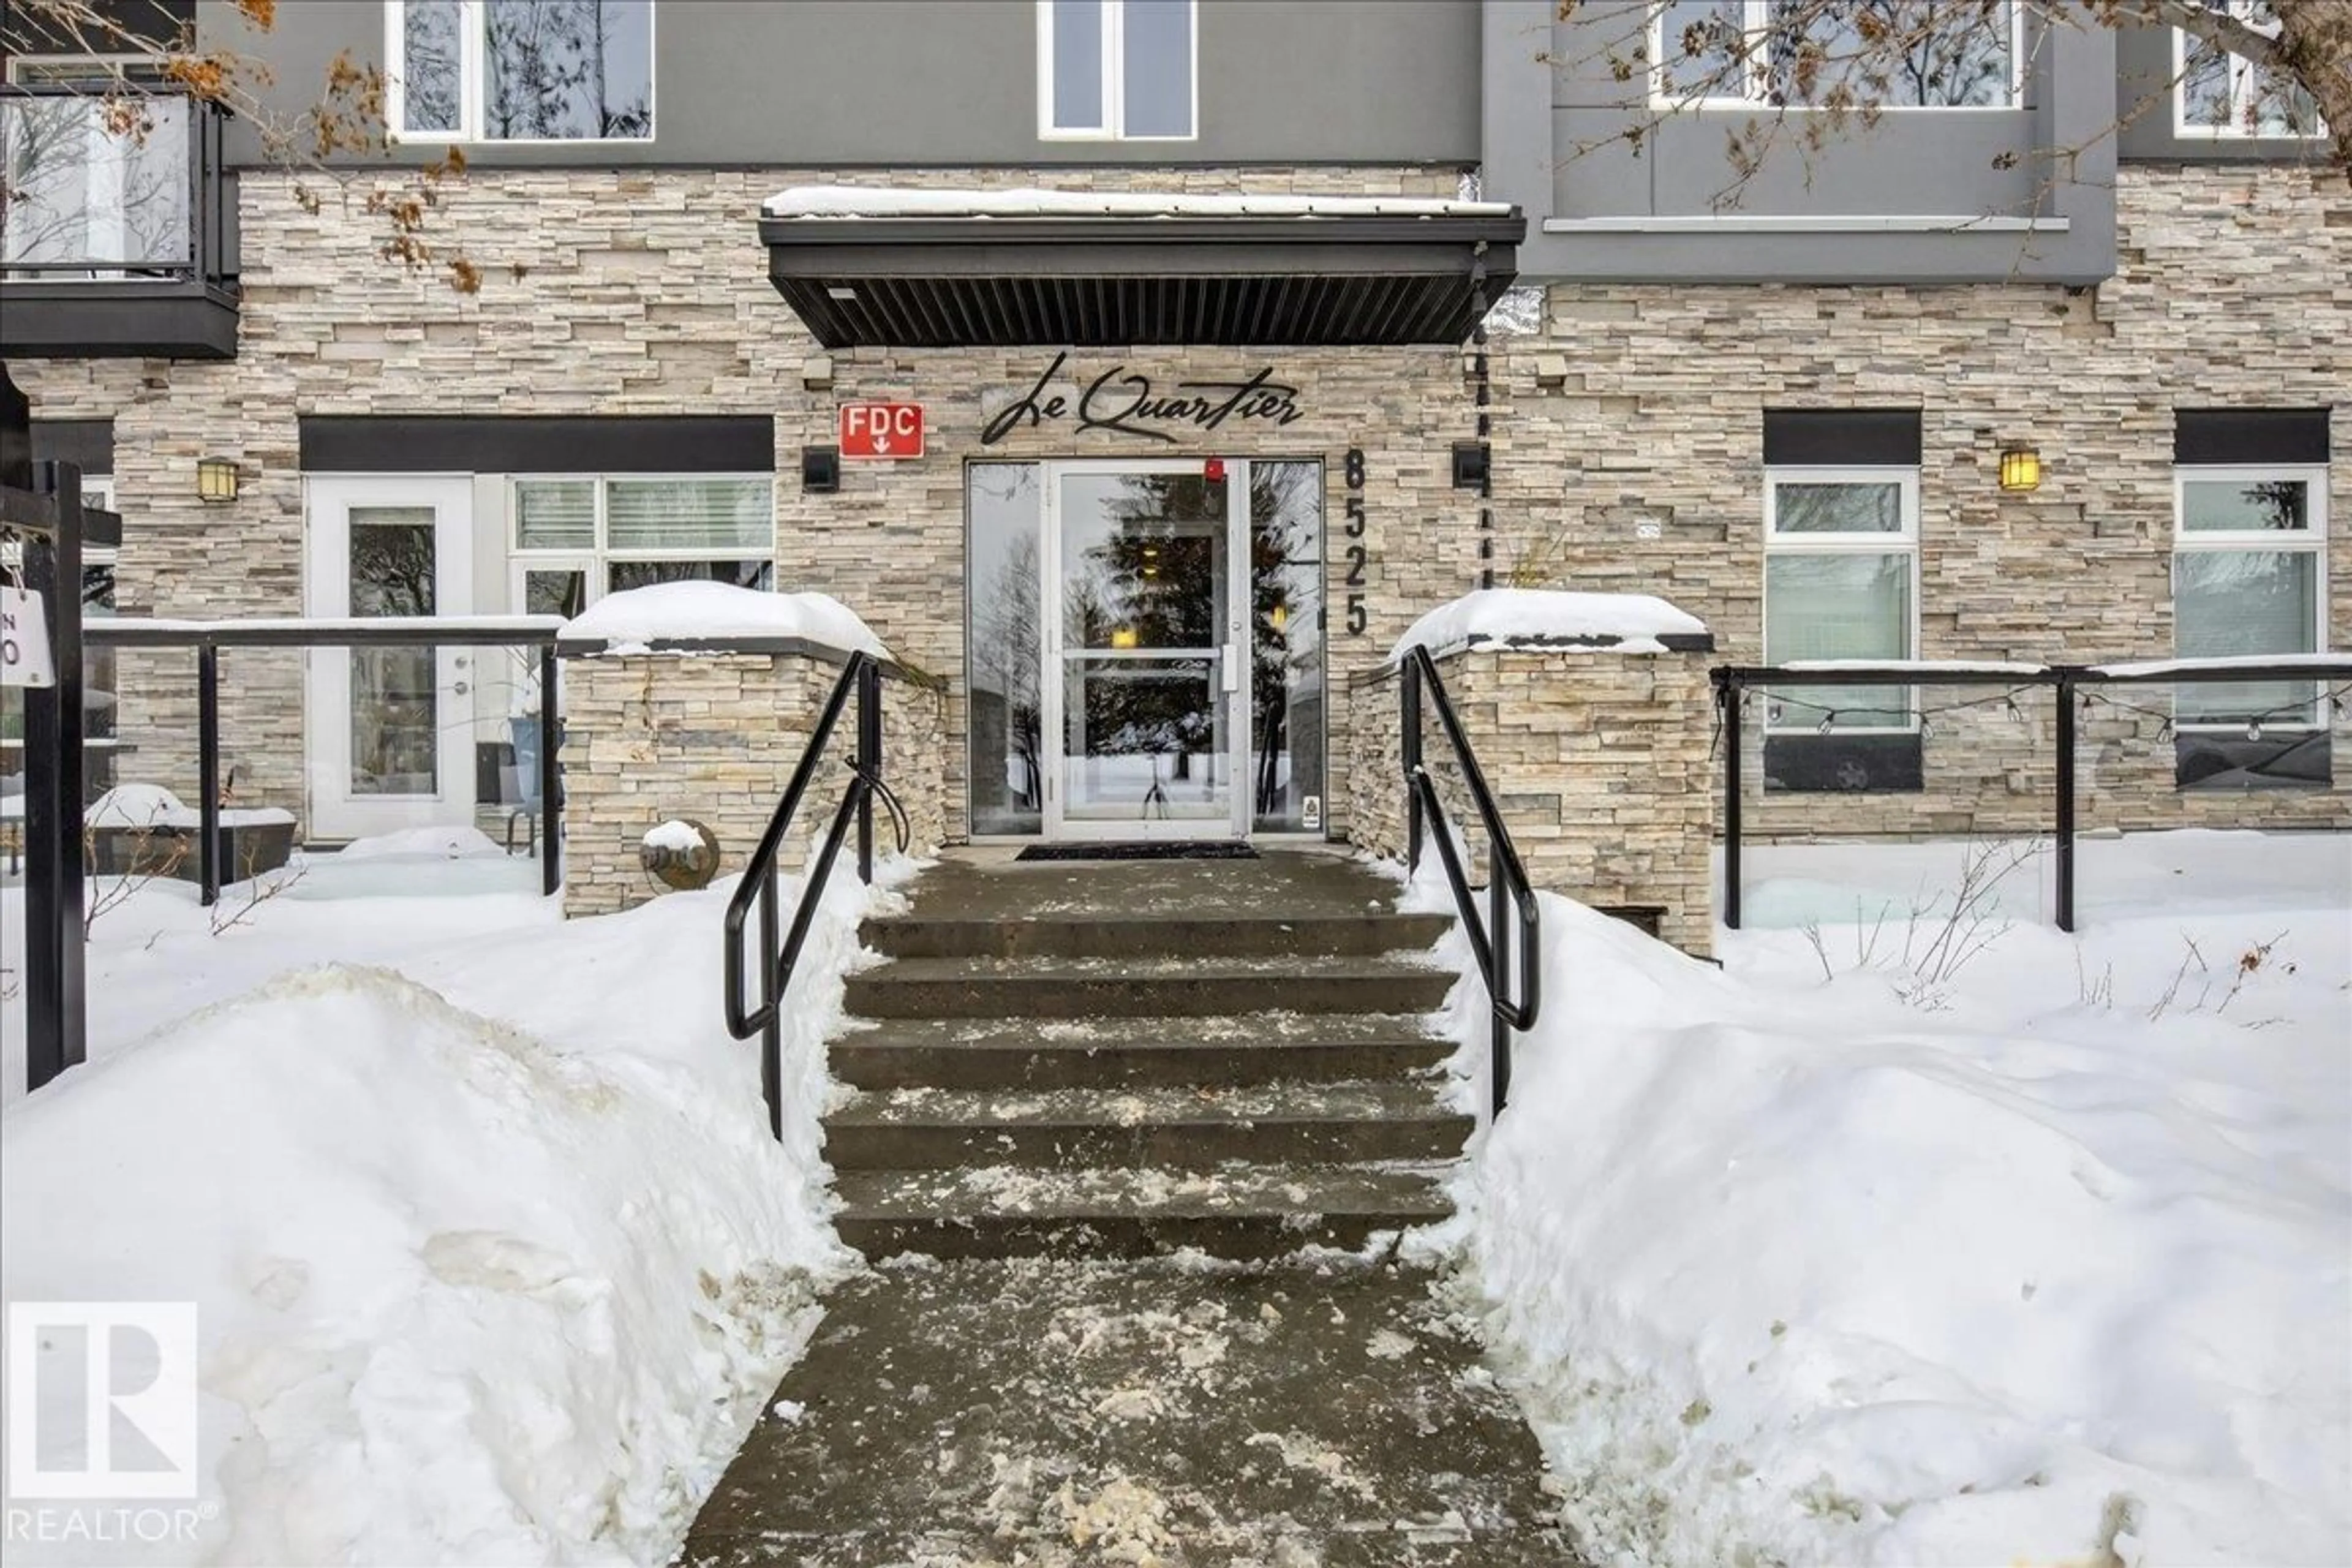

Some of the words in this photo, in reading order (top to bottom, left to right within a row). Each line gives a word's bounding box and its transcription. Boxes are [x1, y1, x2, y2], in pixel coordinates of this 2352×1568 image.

[848, 407, 915, 437] FDC
[981, 351, 1067, 445] Le
[1074, 366, 1305, 443] Quartier
[1345, 448, 1367, 636] 8525
